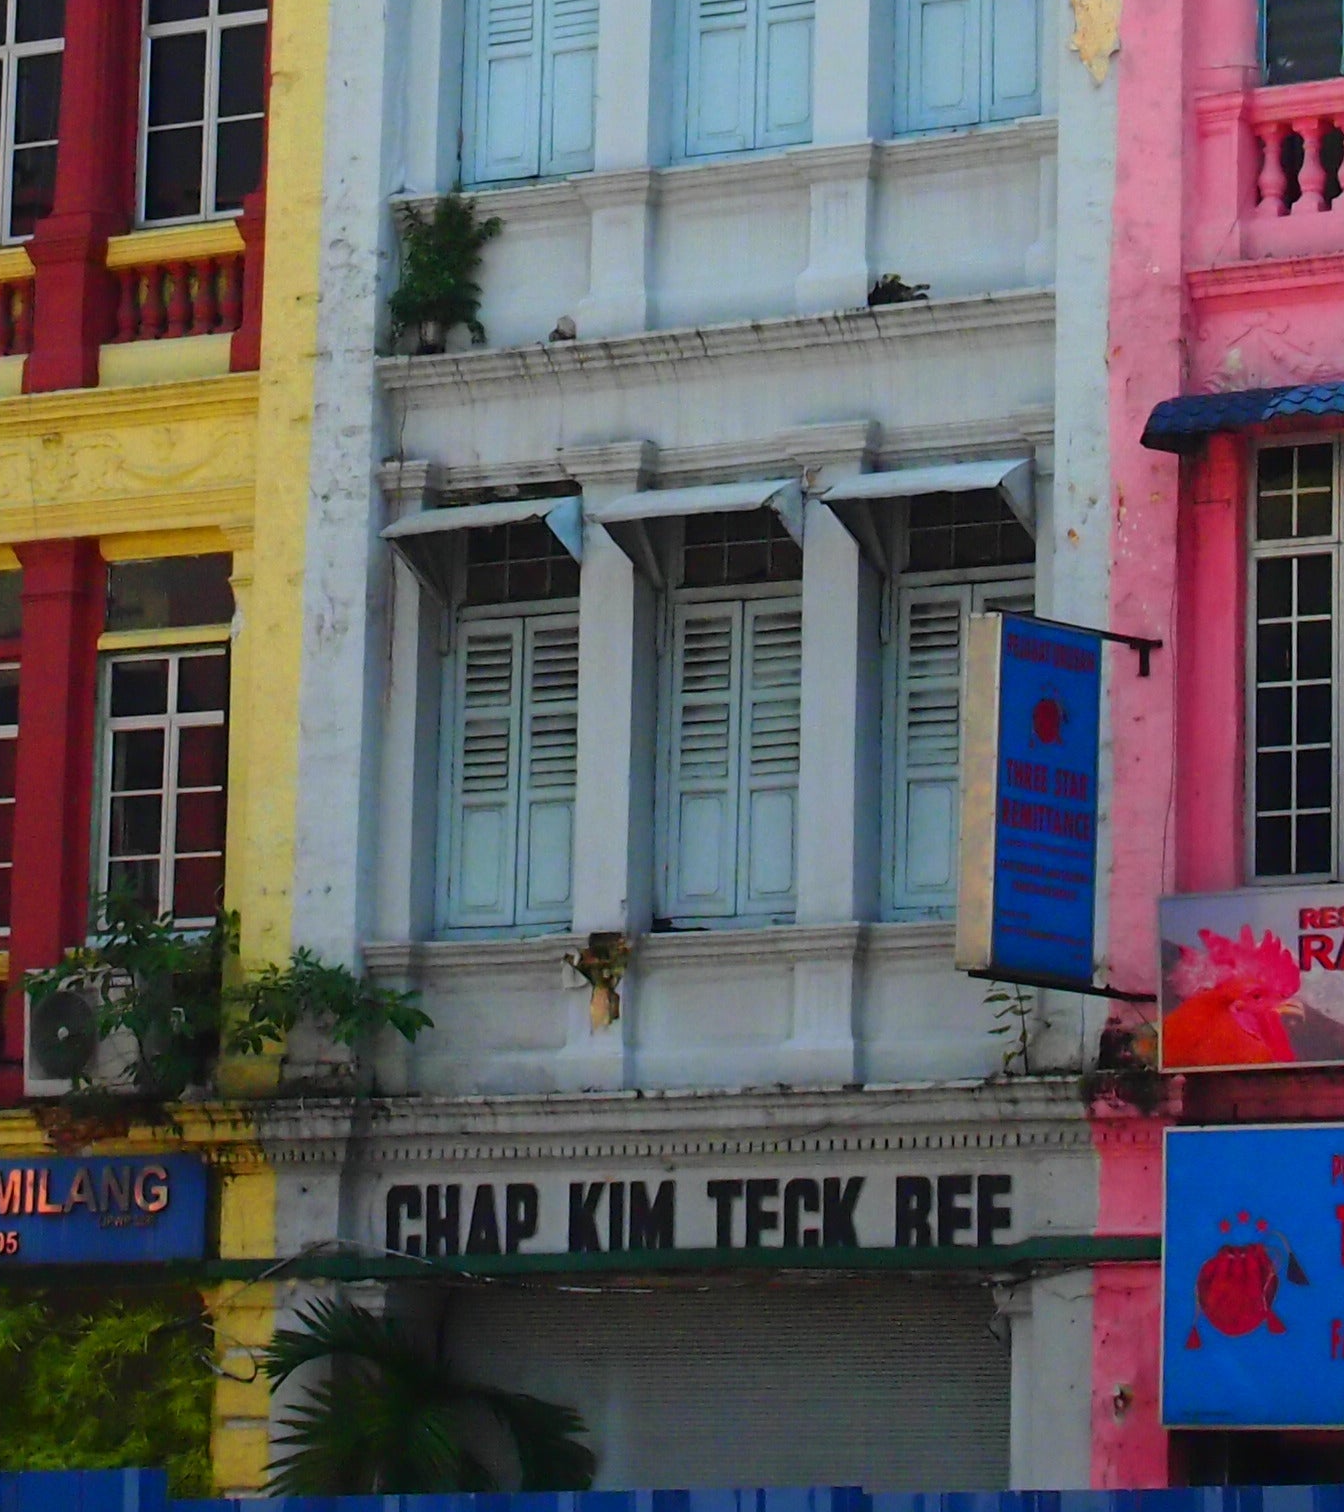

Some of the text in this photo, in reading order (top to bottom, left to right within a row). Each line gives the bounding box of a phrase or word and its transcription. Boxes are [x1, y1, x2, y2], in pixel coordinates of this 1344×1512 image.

[1007, 758, 1089, 802] THREE STAR
[1002, 797, 1091, 842] REMITTANCE
[386, 1182, 539, 1256] CHAP
[568, 1179, 677, 1253] KIM
[707, 1176, 866, 1249] TECK
